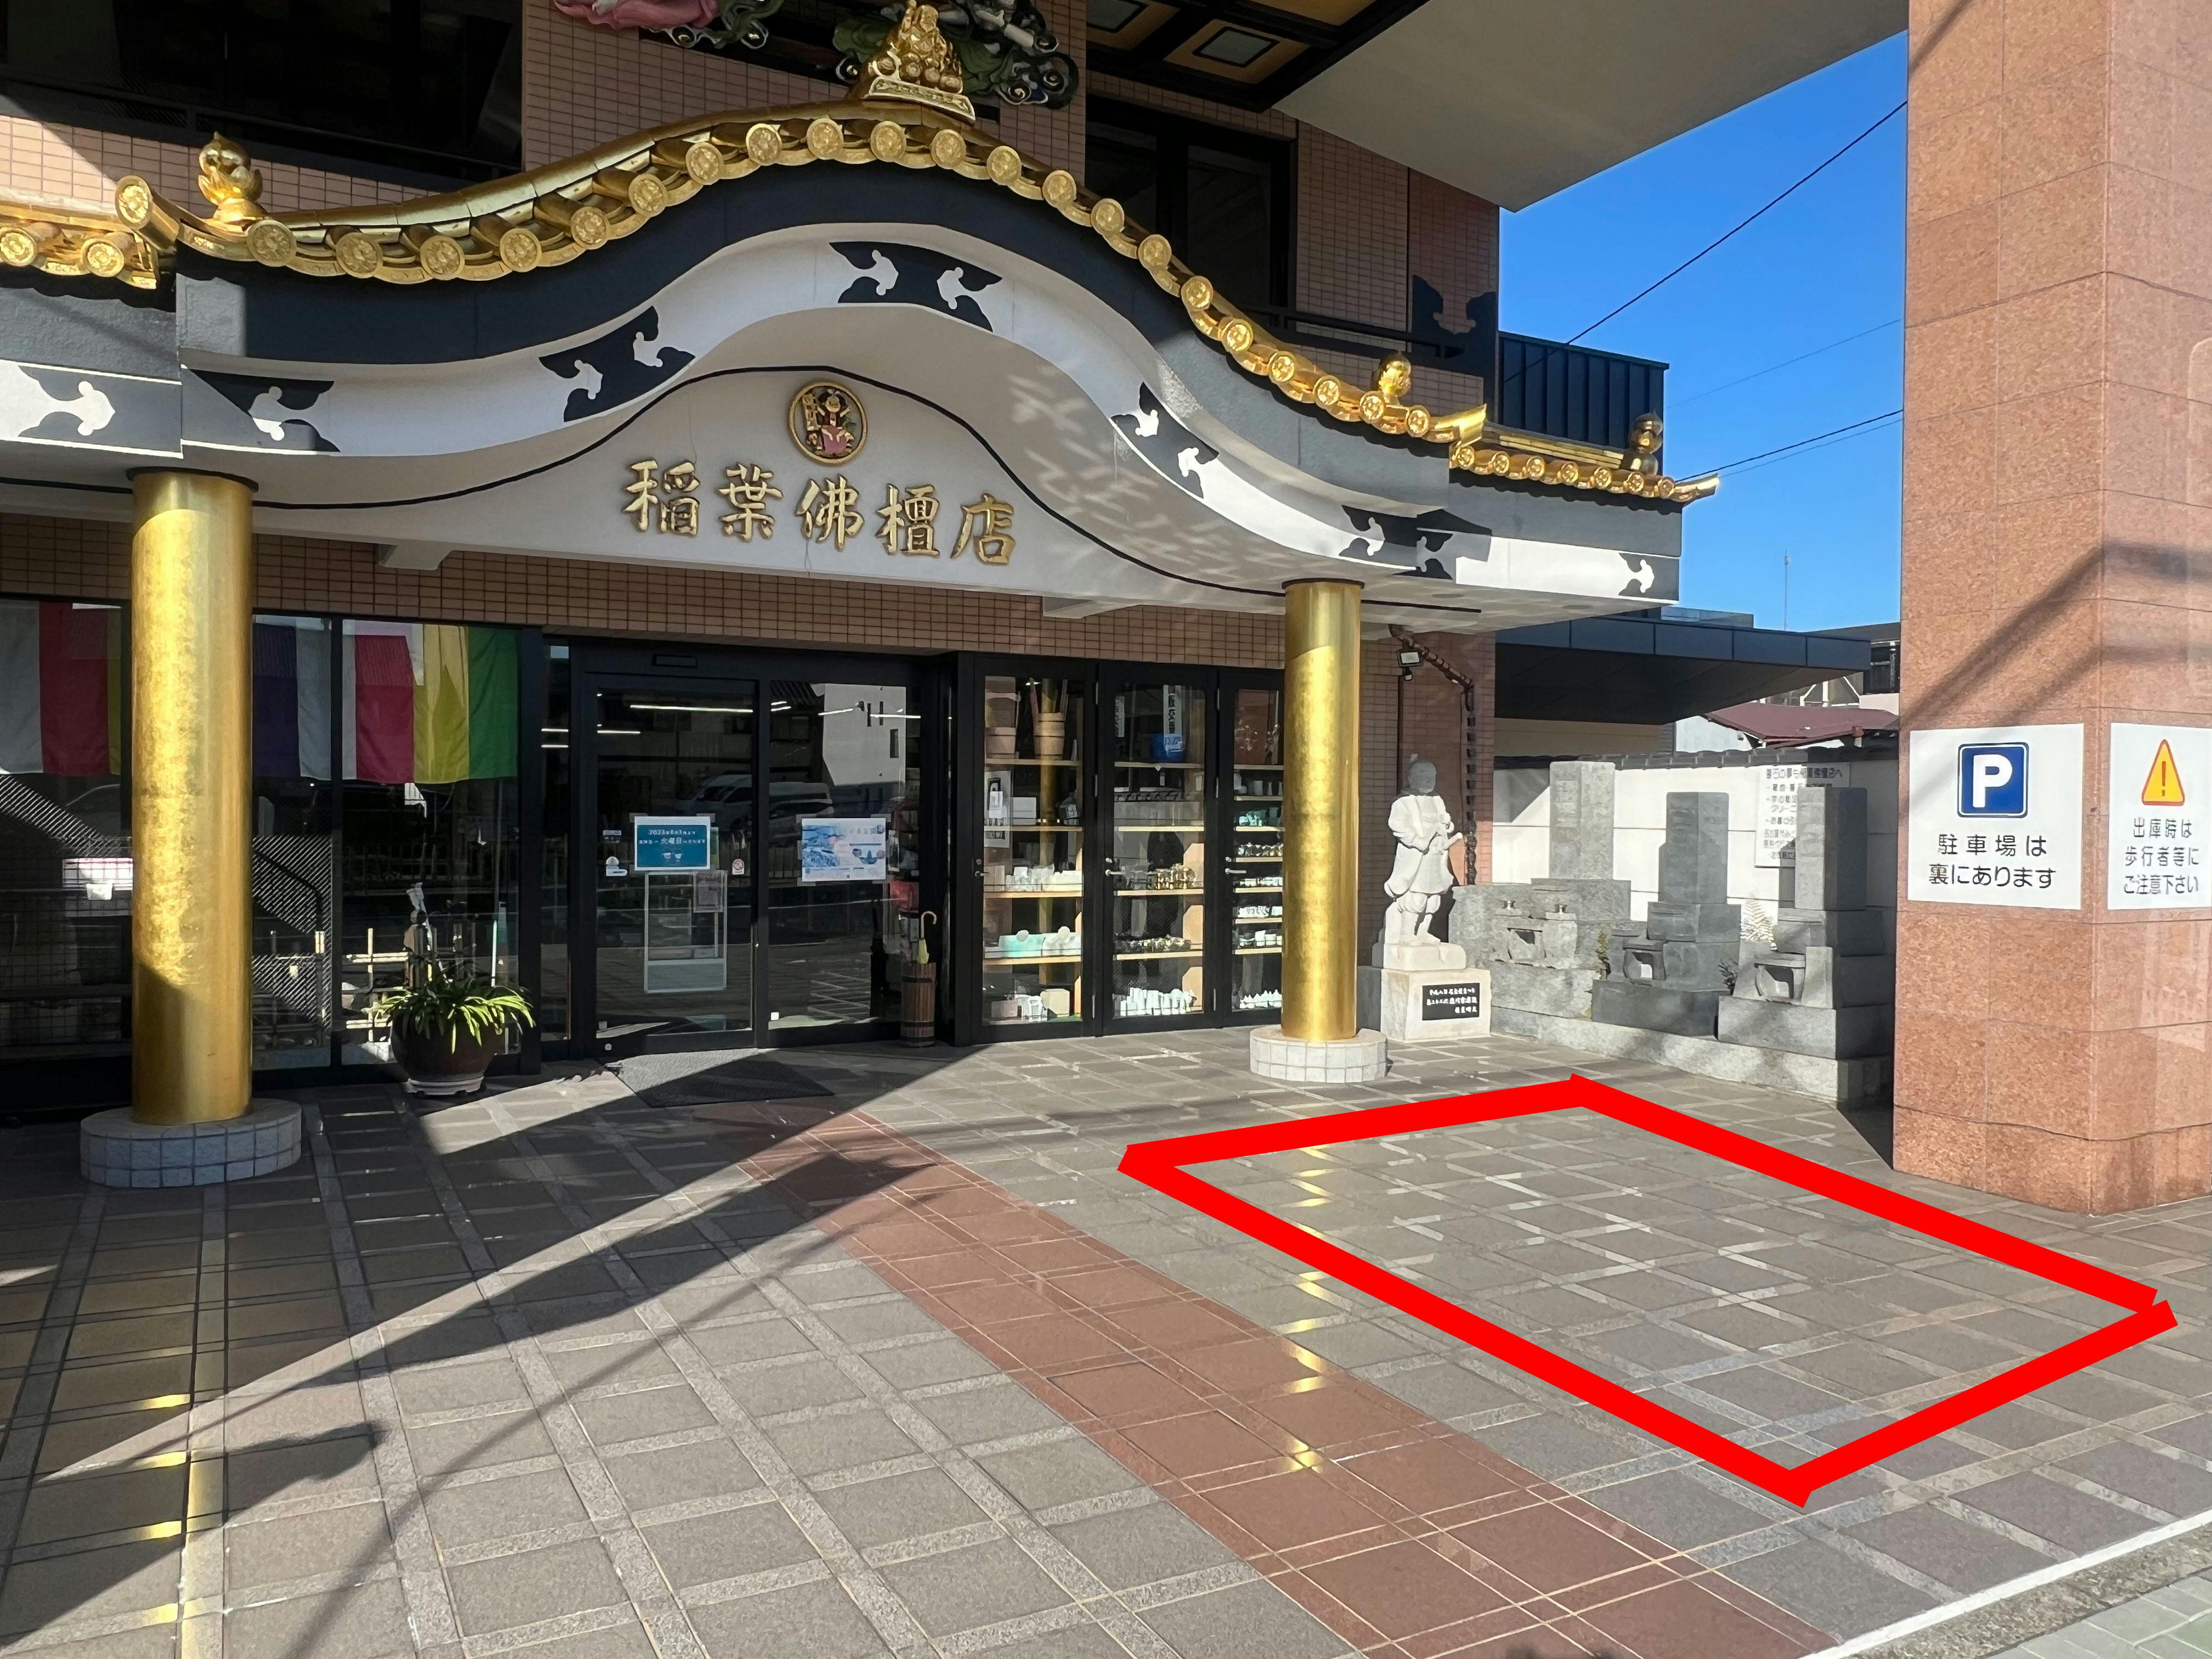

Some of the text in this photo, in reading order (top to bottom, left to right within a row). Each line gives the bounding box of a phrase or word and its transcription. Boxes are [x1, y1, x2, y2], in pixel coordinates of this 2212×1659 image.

[1972, 754, 2013, 808] P
[2134, 817, 2192, 839] 出庫時は
[1938, 834, 2047, 857] 駐車場は
[2125, 845, 2199, 867] 歩行者等に
[1929, 863, 2057, 889] 裏にあります
[2124, 873, 2199, 895] ご注意下さい
